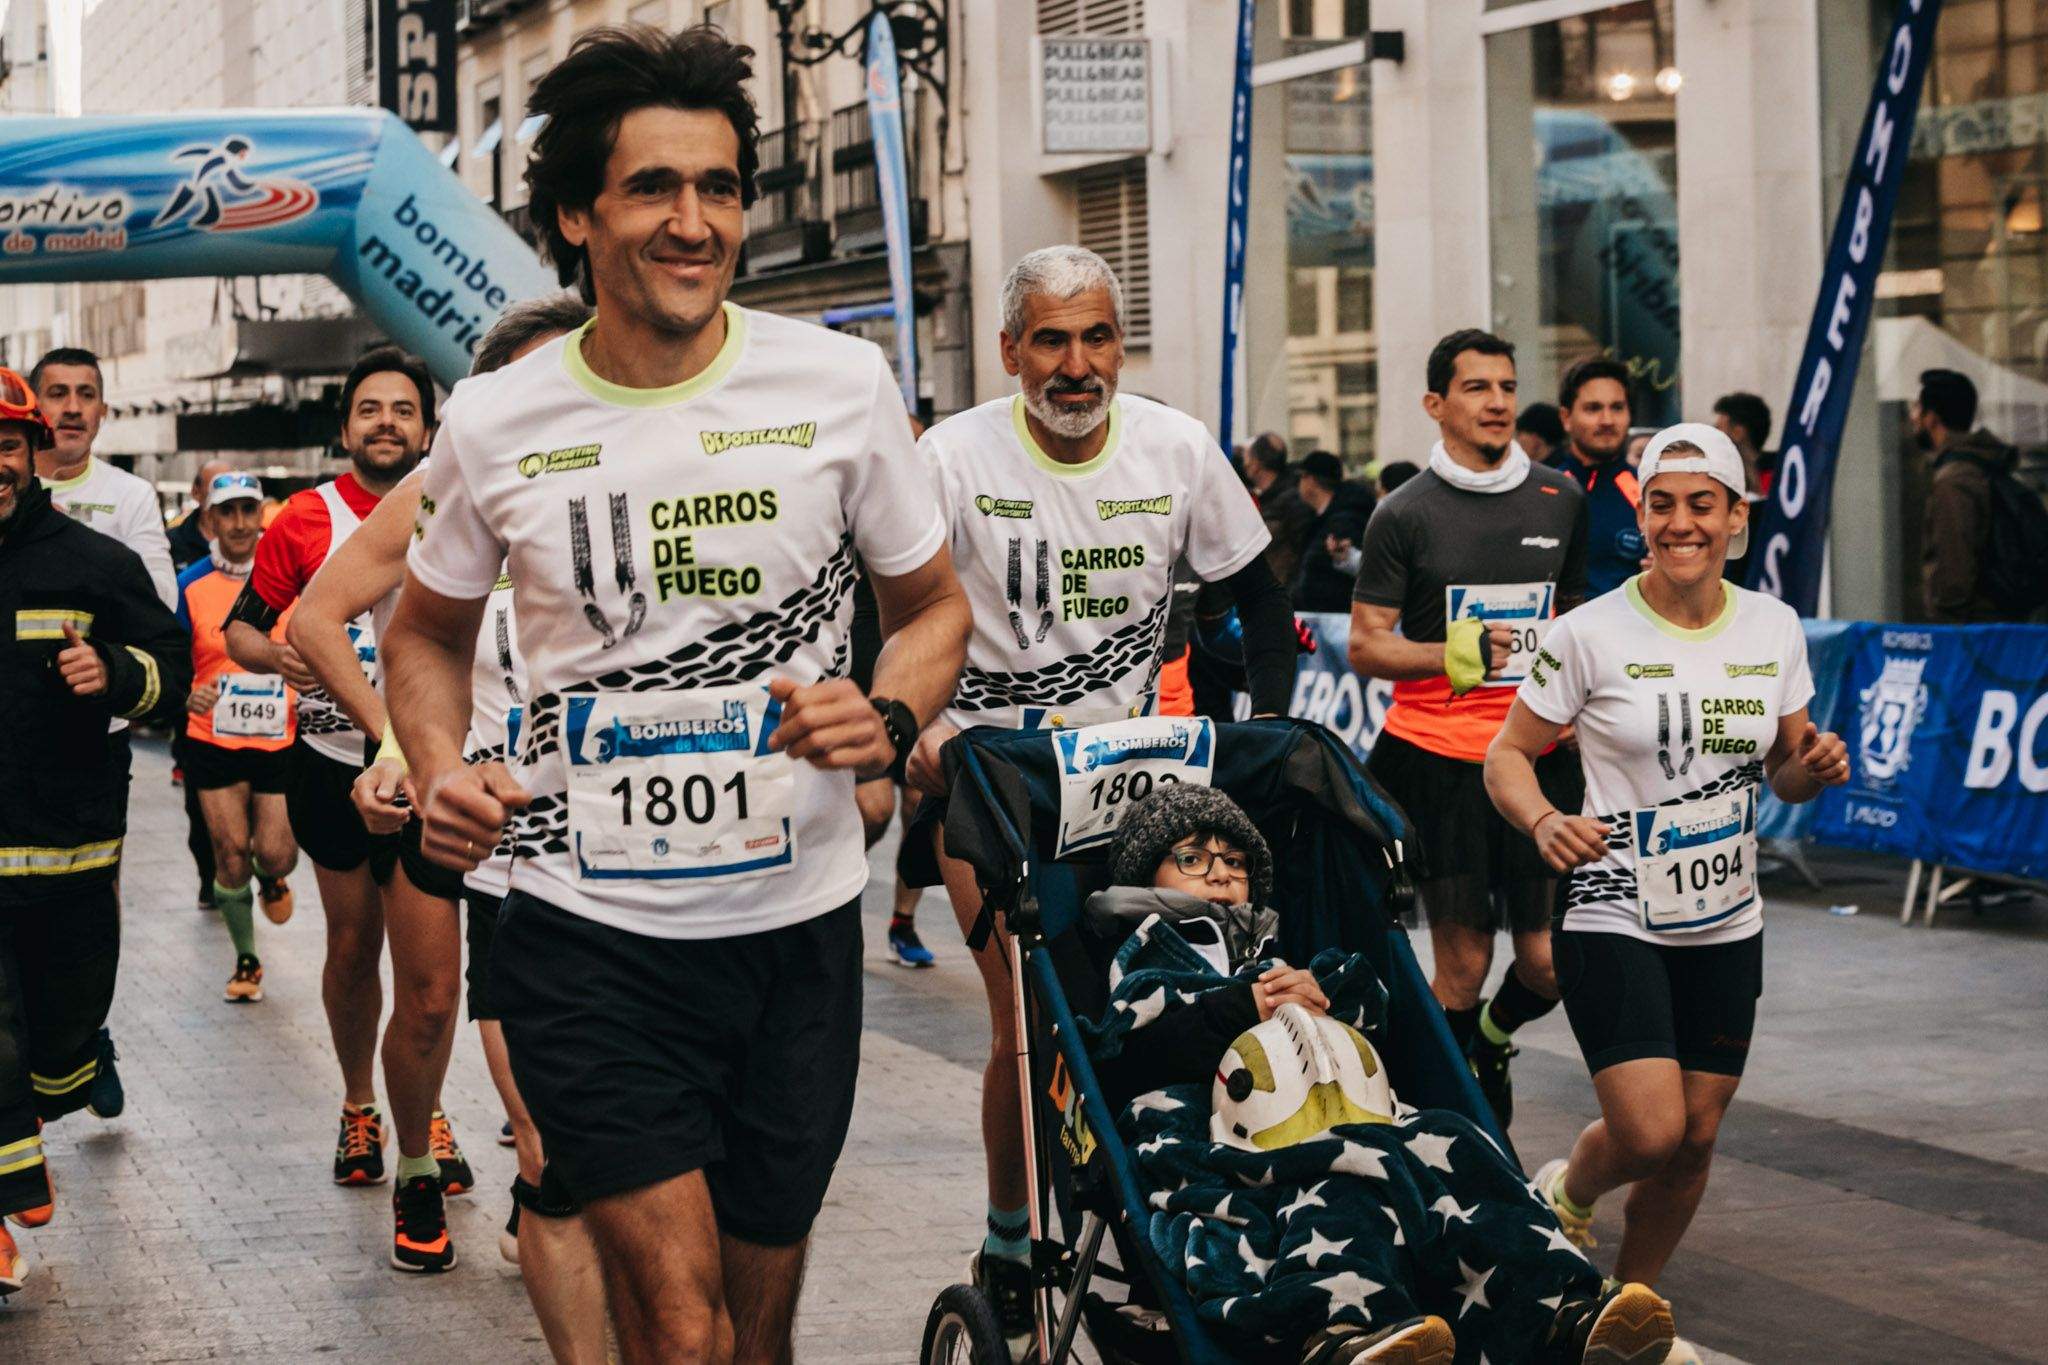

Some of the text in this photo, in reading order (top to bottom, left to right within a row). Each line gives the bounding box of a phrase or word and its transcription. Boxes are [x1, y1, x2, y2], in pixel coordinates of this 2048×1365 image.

[398, 0, 438, 121] SP
[1044, 45, 1144, 60] PULL&BEAR
[1044, 65, 1144, 80] PULL&BEAR
[5, 228, 124, 251] de madrid
[394, 195, 516, 309] bombe
[1758, 0, 1922, 598] OMBEROS
[700, 421, 817, 455] DEPORTEMANIA
[651, 490, 778, 531] CARROS
[995, 498, 1033, 511] SPORTING
[1096, 494, 1173, 521] DEPORTEMANIA
[653, 536, 694, 569] DE
[1061, 544, 1145, 570] CARROS
[657, 566, 761, 602] FUEGO
[1062, 573, 1087, 595] DE
[1063, 596, 1129, 621] FUEGO
[230, 702, 276, 720] 1649
[1701, 698, 1765, 716] CARROS
[629, 717, 746, 740] BOMBEROS
[1702, 718, 1725, 735] DE
[1108, 736, 1187, 752] BOMBEROS
[1701, 738, 1757, 755] FUEGO
[611, 771, 748, 826] 1801
[1666, 845, 1744, 895] 1094
